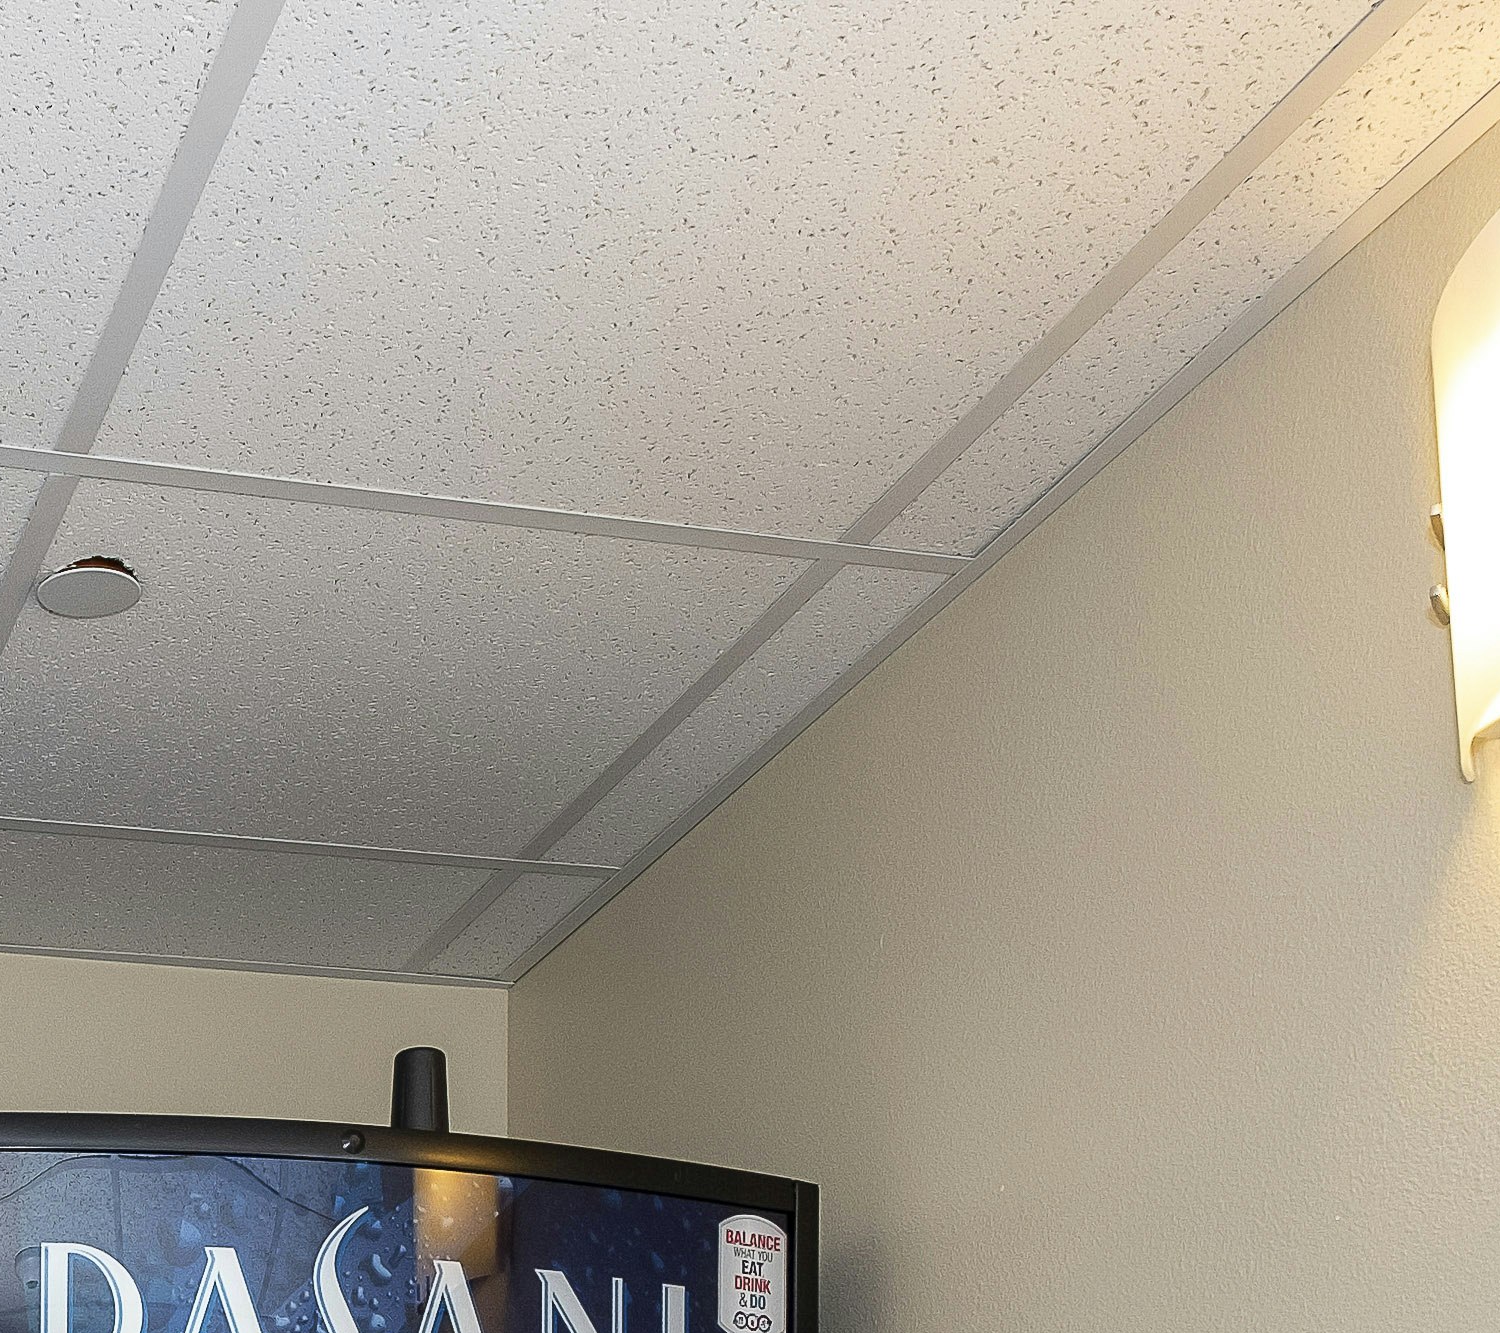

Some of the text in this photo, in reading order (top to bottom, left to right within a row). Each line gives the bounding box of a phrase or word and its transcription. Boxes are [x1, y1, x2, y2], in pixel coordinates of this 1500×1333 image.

[725, 1228, 781, 1252] BALANCE
[733, 1246, 773, 1263] WHAT YOU
[734, 1274, 771, 1295] DRINK
[738, 1292, 766, 1310] & DO
